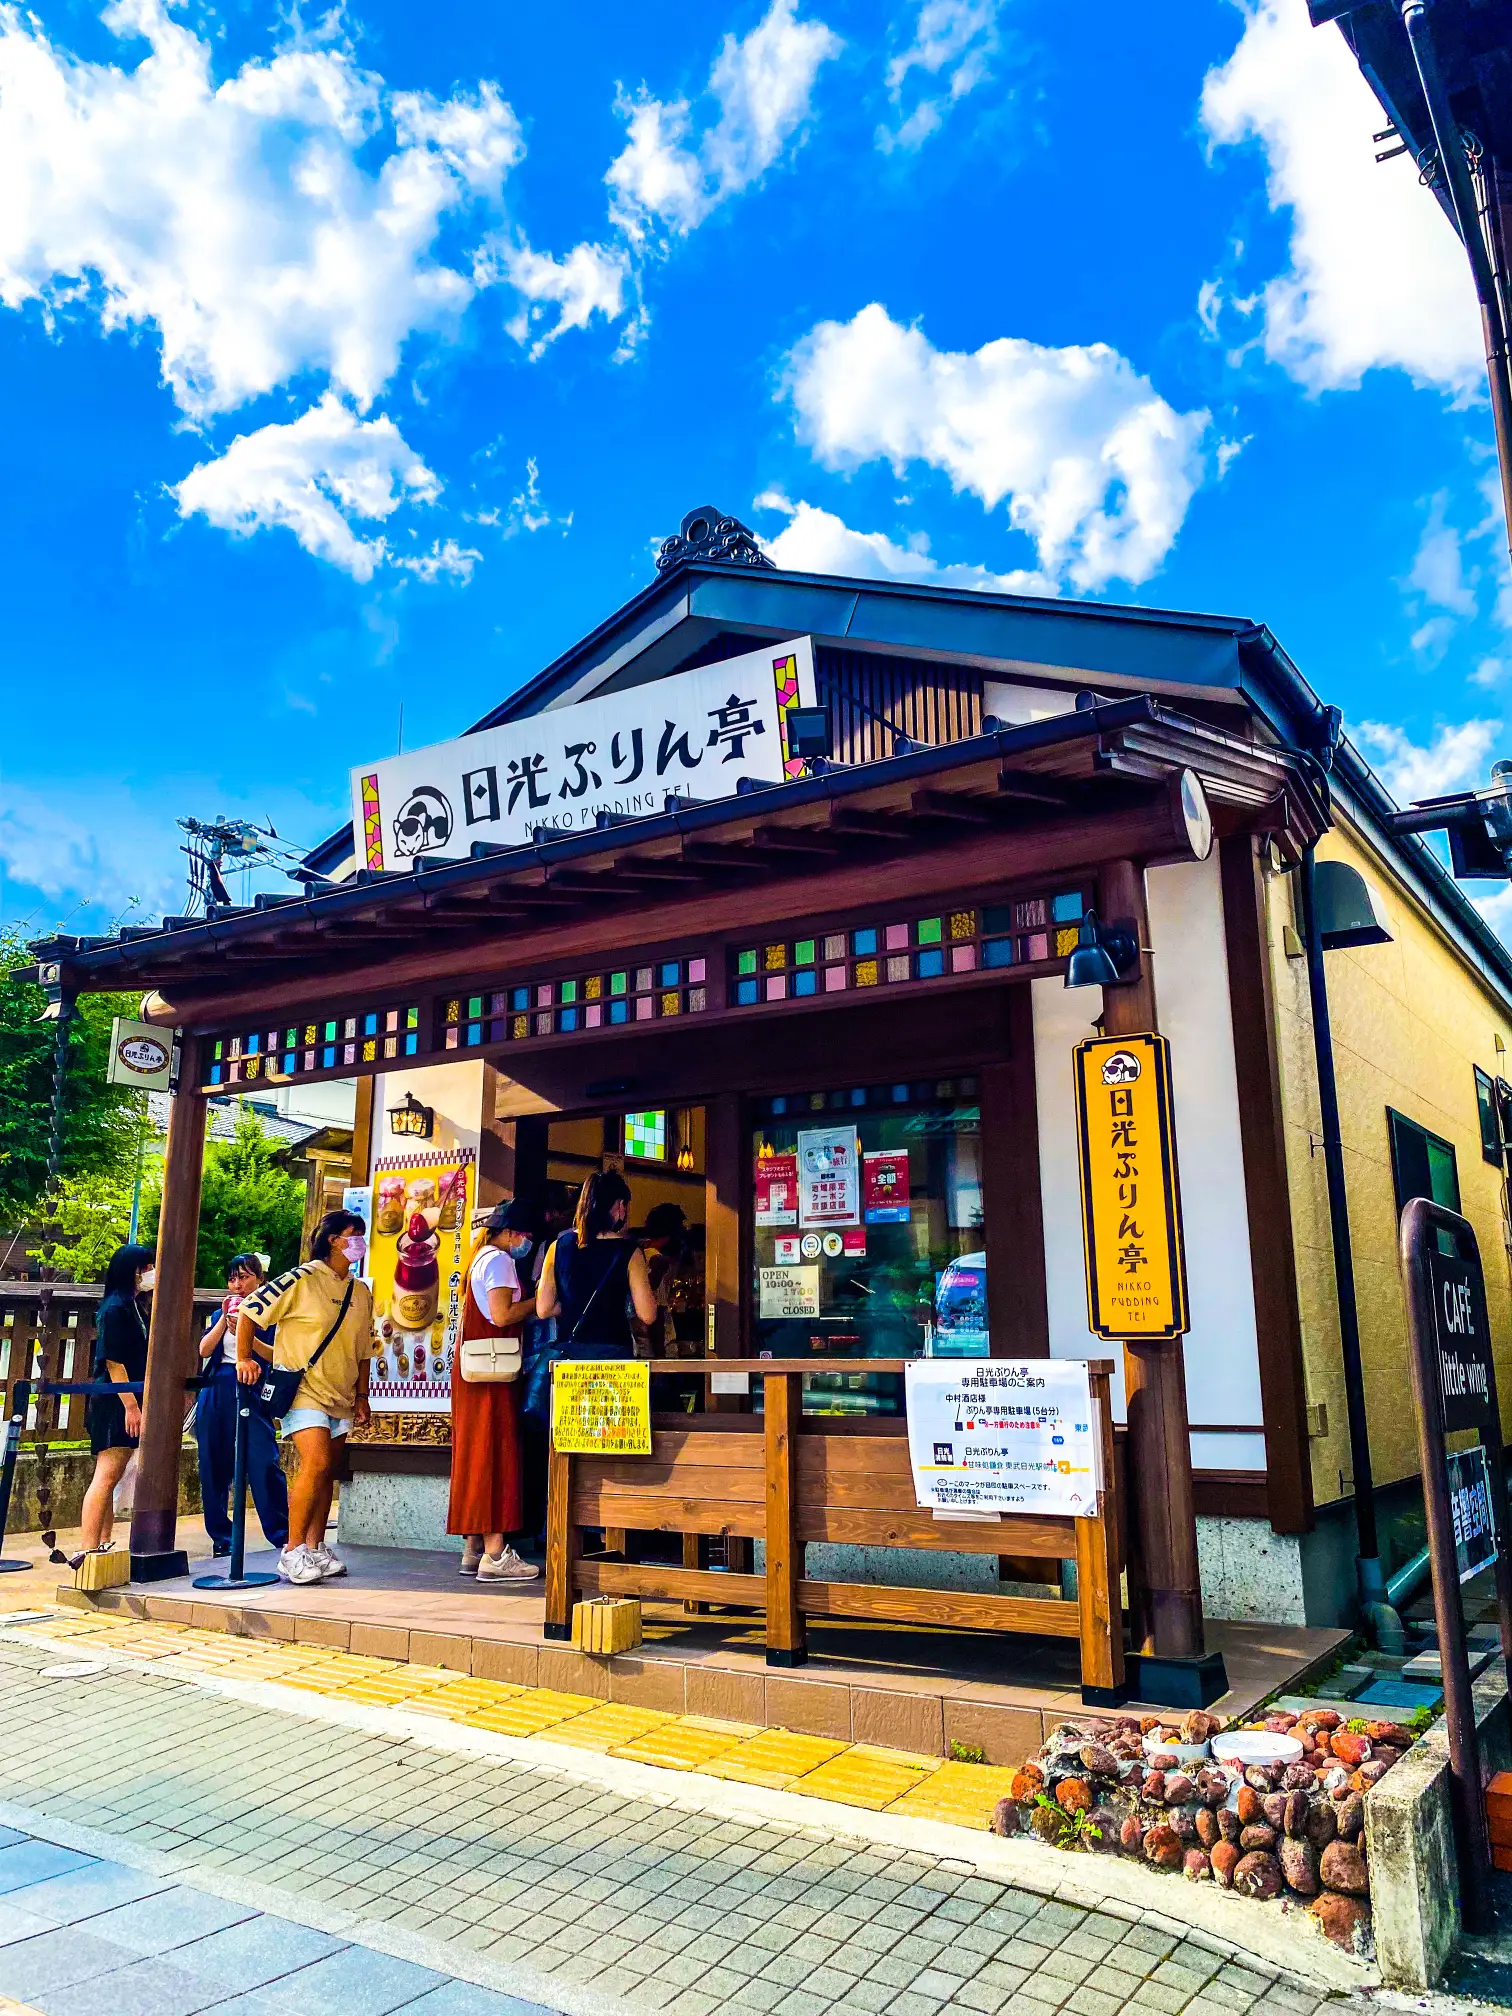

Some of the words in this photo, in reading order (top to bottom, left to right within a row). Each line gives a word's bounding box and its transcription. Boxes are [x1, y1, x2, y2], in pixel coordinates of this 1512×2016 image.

[462, 693, 765, 826] 日光ぷりん亭
[525, 812, 573, 838] NIKKO
[1109, 1089, 1148, 1274] 日光ぷりん亭
[812, 1192, 846, 1201] クーポン
[762, 1270, 790, 1280] OPEN
[1117, 1281, 1152, 1292] NIKKO
[1111, 1296, 1159, 1307] PUDDING
[1443, 1276, 1475, 1334] CAFÉ
[782, 1306, 815, 1315] CLOSED
[1127, 1311, 1146, 1322] TEI
[976, 1367, 1029, 1378] 日光ぷりん亭
[1441, 1350, 1466, 1396] little
[1466, 1352, 1489, 1404] wing
[961, 1377, 1045, 1388] 専用駐車場のご案内
[945, 1393, 986, 1403] 中村酒店様
[965, 1446, 1009, 1457] 日光ぷりん亭
